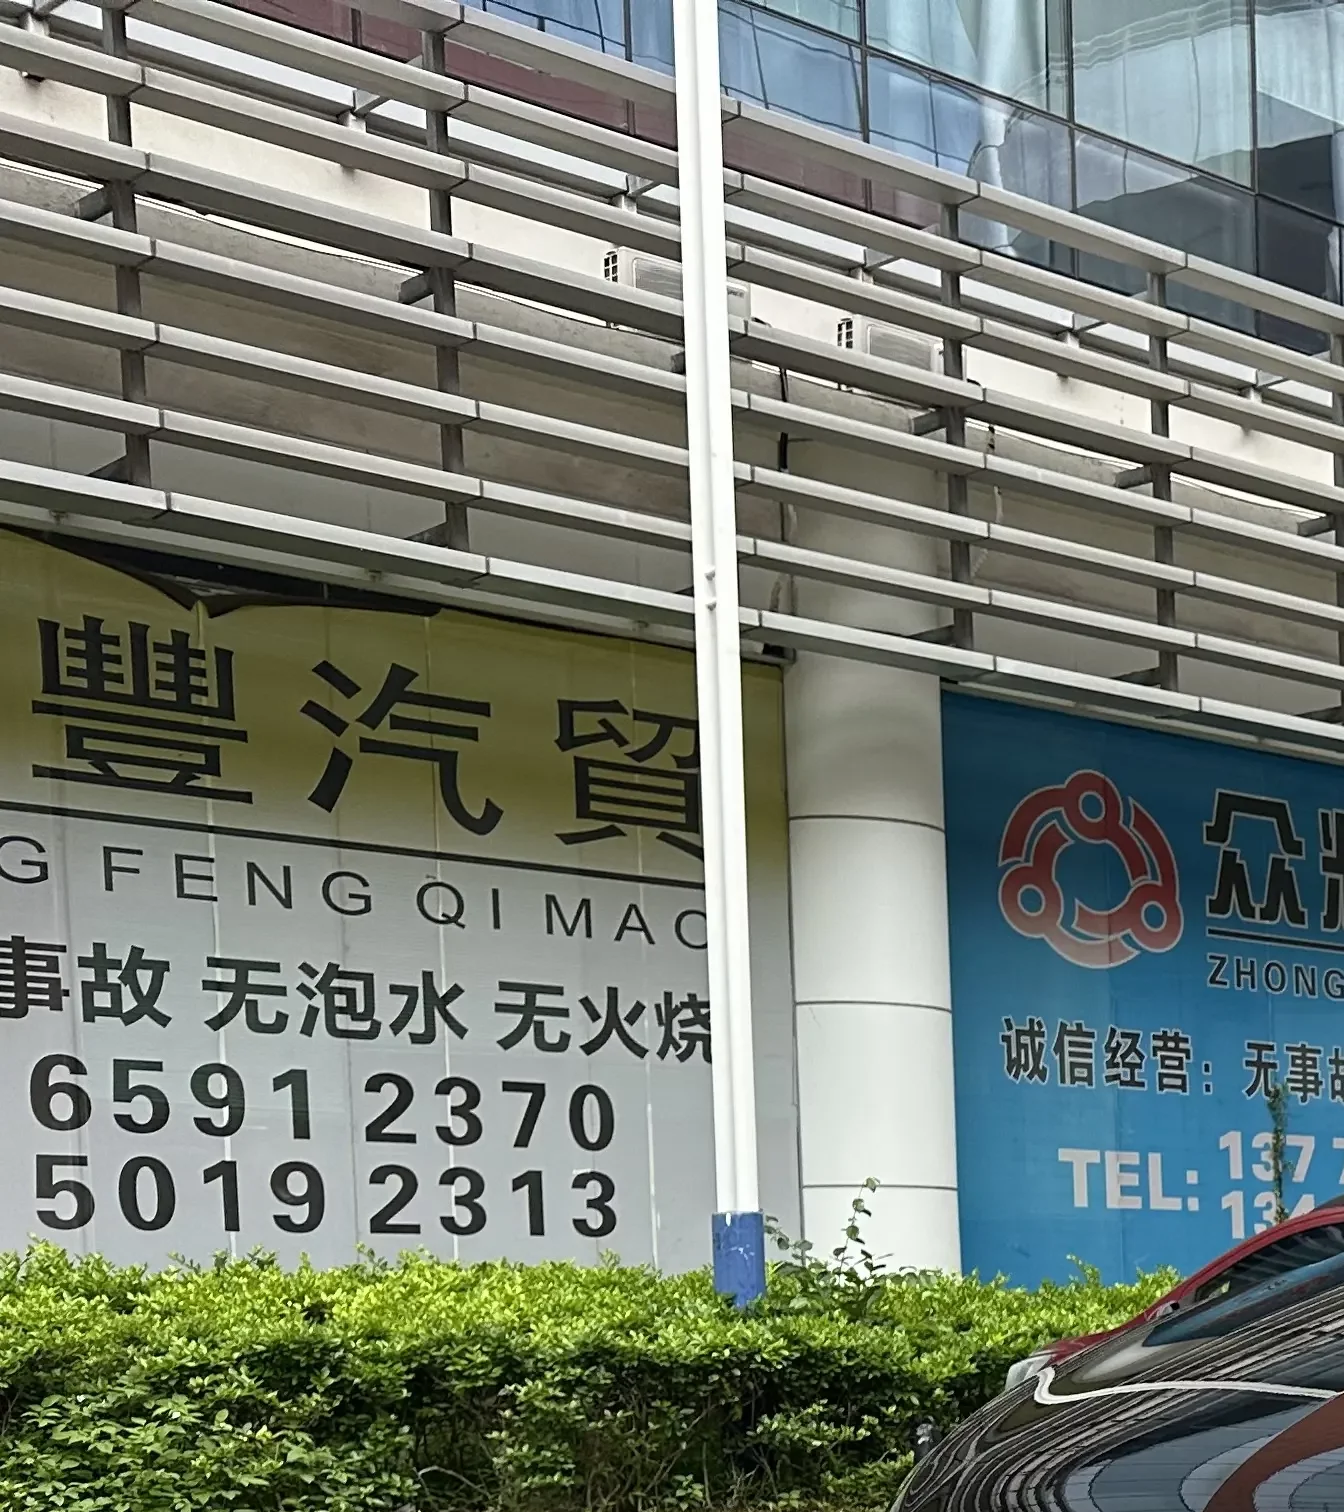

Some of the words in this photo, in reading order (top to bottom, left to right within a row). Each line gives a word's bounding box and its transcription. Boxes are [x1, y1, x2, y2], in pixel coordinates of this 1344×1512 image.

[103, 846, 372, 915] FENG
[417, 881, 500, 929] QI
[202, 956, 468, 1044] 无泡水
[494, 981, 712, 1064] 无火烧
[1000, 1015, 1213, 1095] 诚信经营：
[30, 1054, 311, 1140] 6591
[364, 1073, 614, 1152] 2370
[36, 1154, 325, 1233] 5019
[369, 1164, 617, 1238] 2313
[1058, 1147, 1200, 1212] TEL:
[1219, 1130, 1315, 1184] 137
